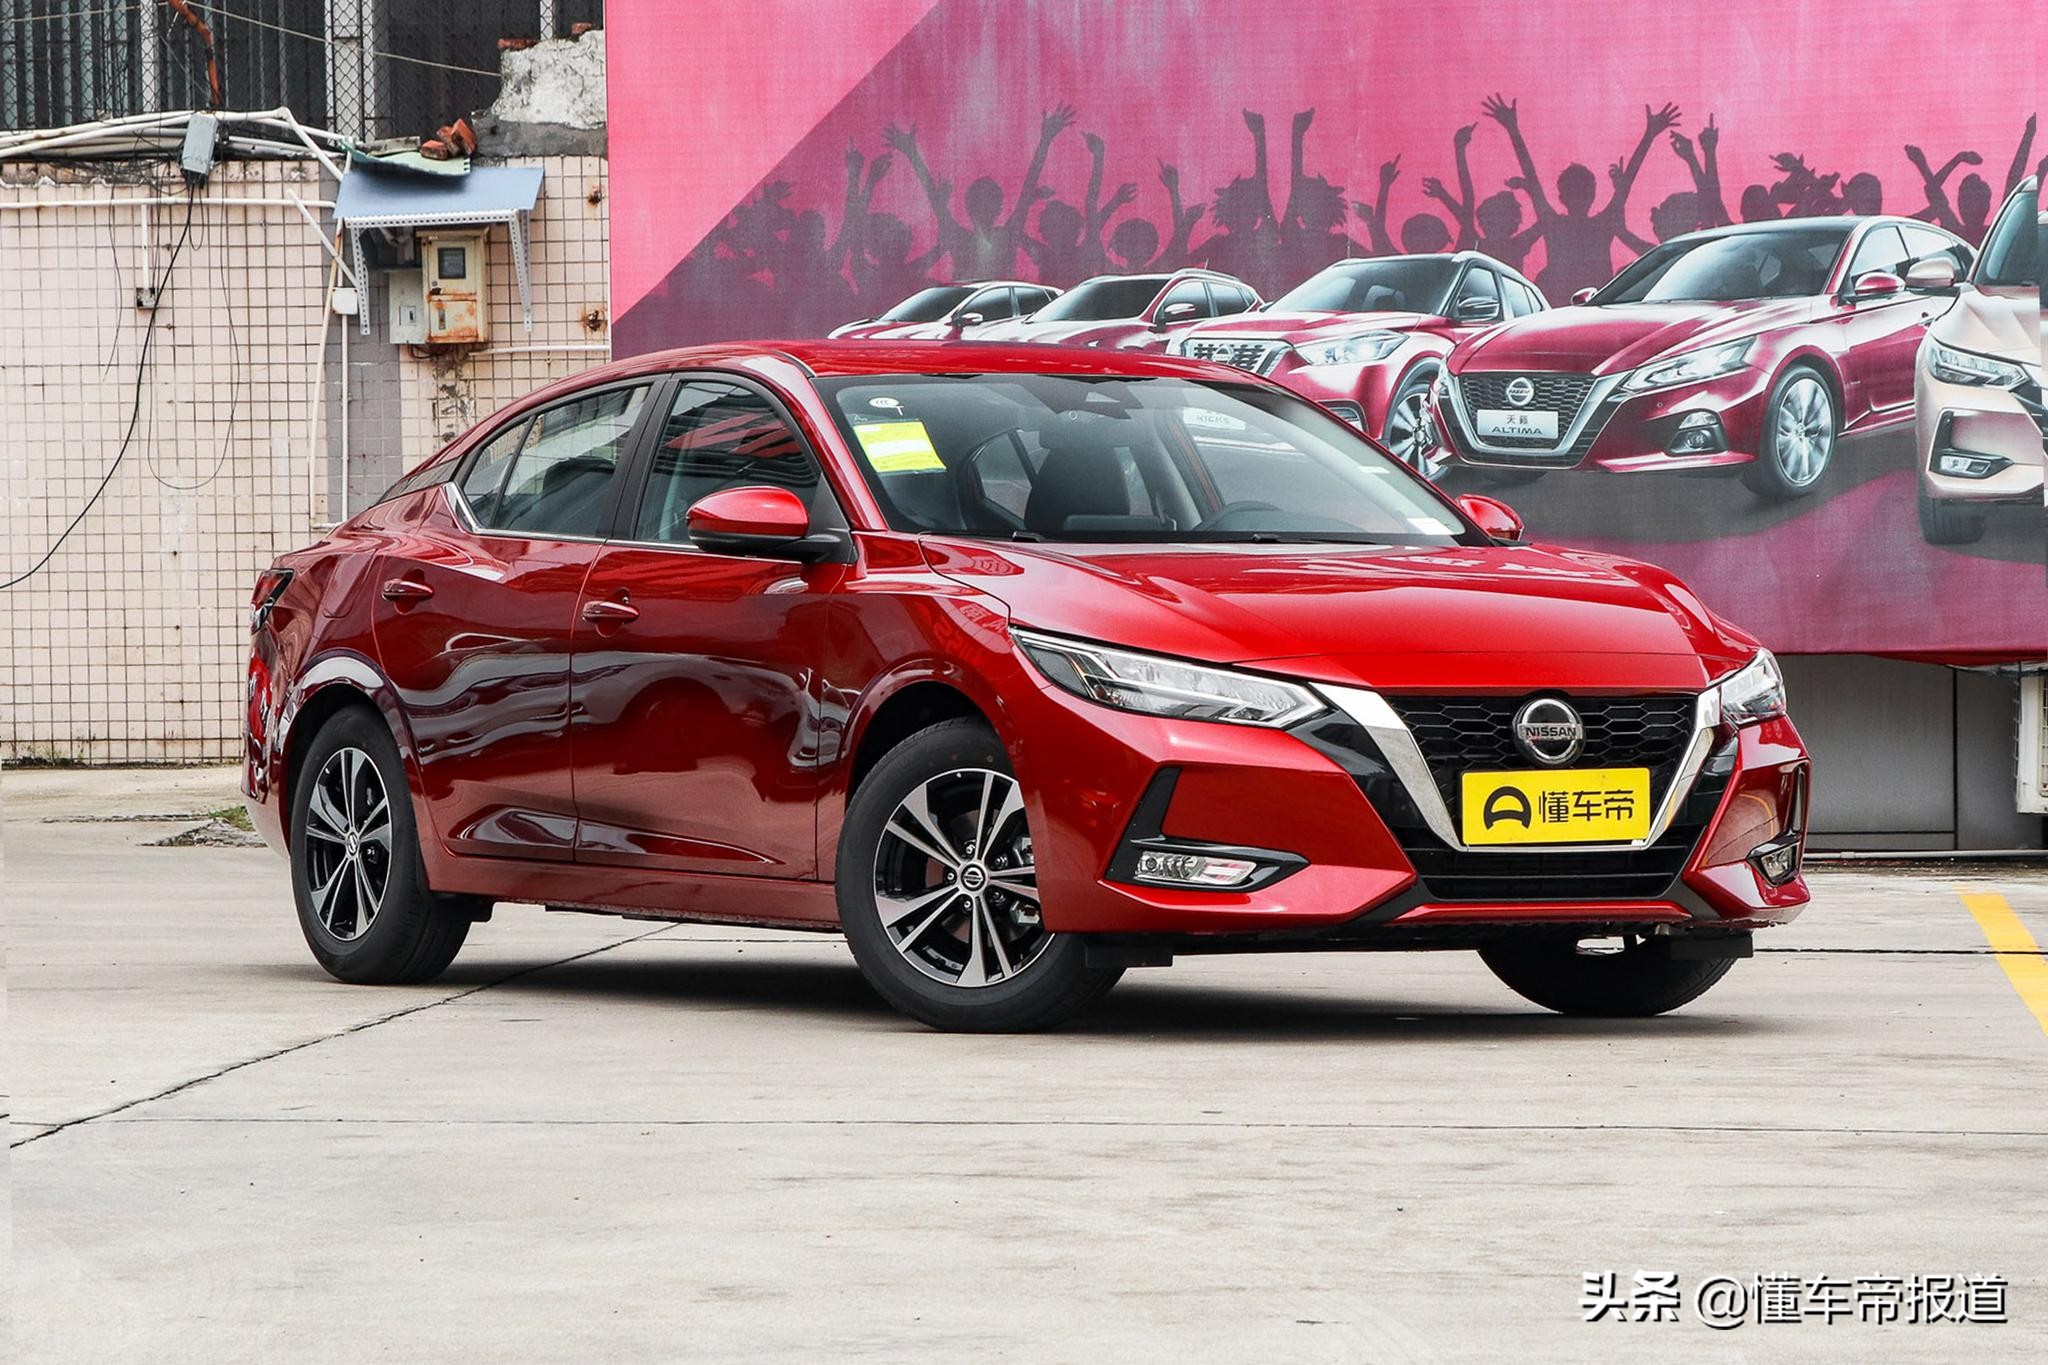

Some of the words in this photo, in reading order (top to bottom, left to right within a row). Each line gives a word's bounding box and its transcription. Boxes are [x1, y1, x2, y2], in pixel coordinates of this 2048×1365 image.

[1492, 425, 1543, 435] ALTIMA
[1525, 726, 1577, 737] NISSAN
[1538, 789, 1635, 824] 懂车帝
